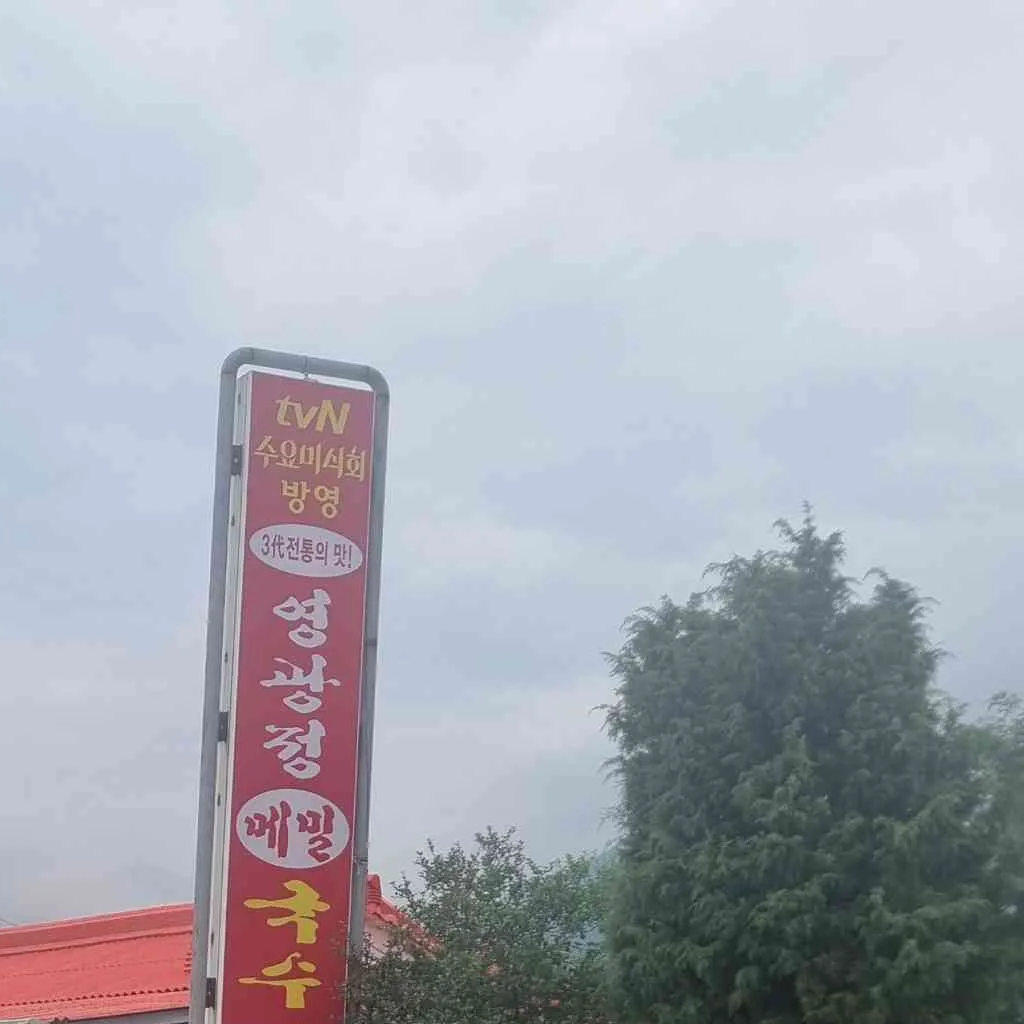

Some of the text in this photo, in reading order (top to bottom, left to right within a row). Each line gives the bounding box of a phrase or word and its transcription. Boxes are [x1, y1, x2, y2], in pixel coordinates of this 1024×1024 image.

[275, 395, 351, 434] tvN
[254, 435, 366, 481] 수요미식회
[261, 533, 352, 568] 3代전통의 맛!
[260, 589, 341, 779] 영광정
[244, 800, 335, 863] 메밀
[237, 879, 331, 1009] 국수
